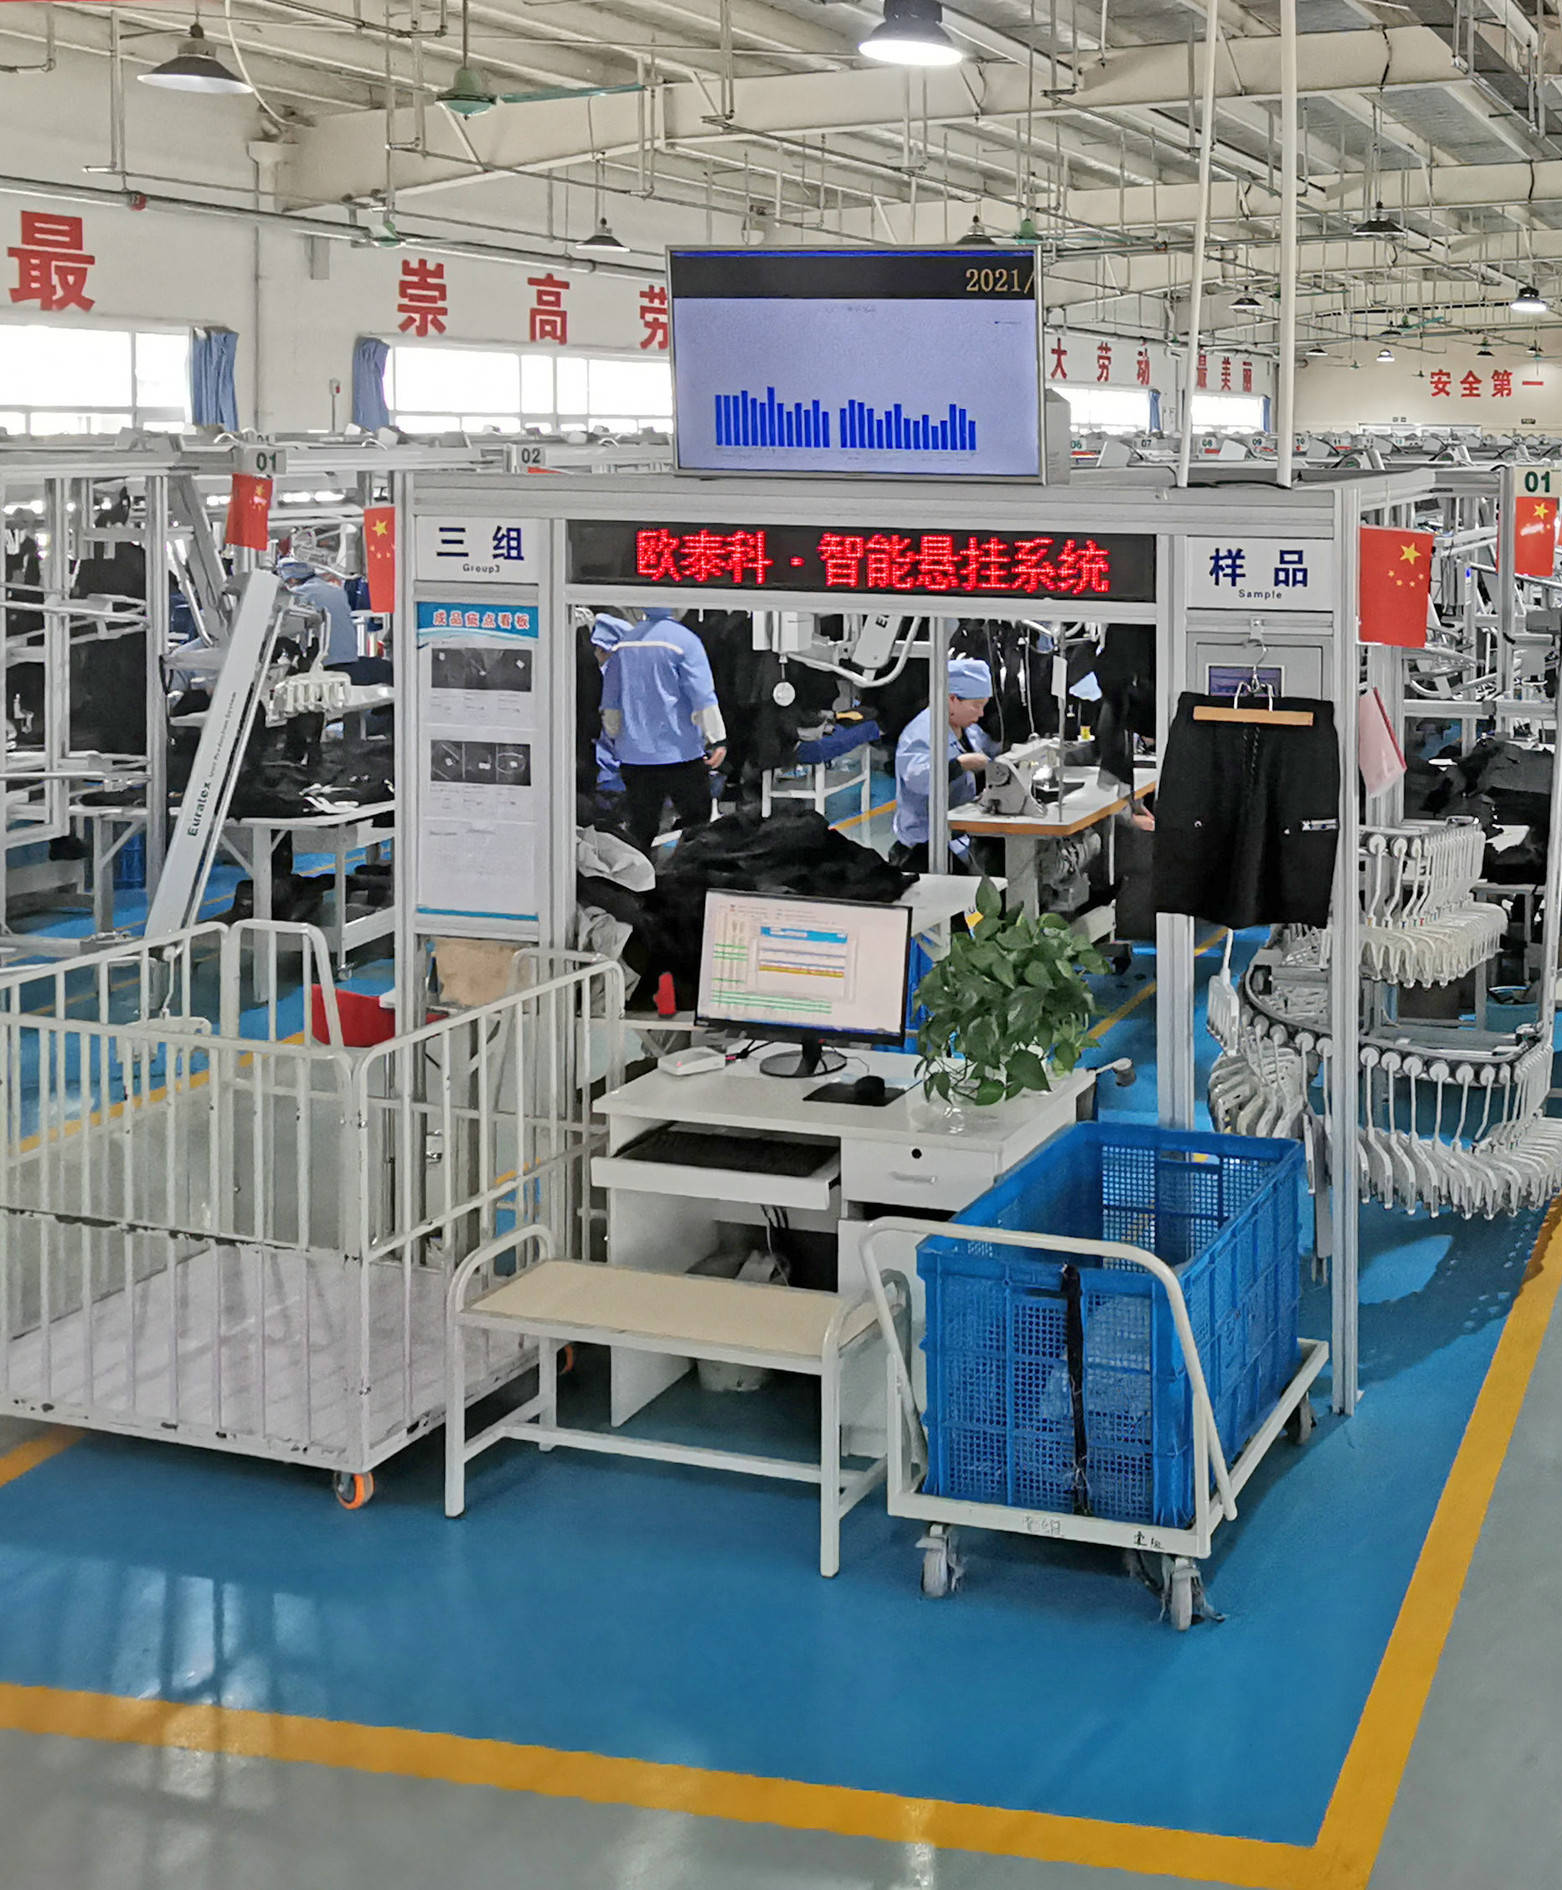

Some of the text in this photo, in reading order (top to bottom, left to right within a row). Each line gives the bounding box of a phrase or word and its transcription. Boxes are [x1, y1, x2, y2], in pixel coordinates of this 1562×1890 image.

[8, 210, 95, 311] 最
[1430, 369, 1545, 398] 安全第一
[256, 452, 277, 471] 01
[521, 447, 541, 464] 02
[1524, 471, 1550, 493] 01
[436, 525, 524, 561] 三组
[463, 563, 501, 575] Group3
[1209, 548, 1309, 588] 样品
[1238, 588, 1283, 600] Sample
